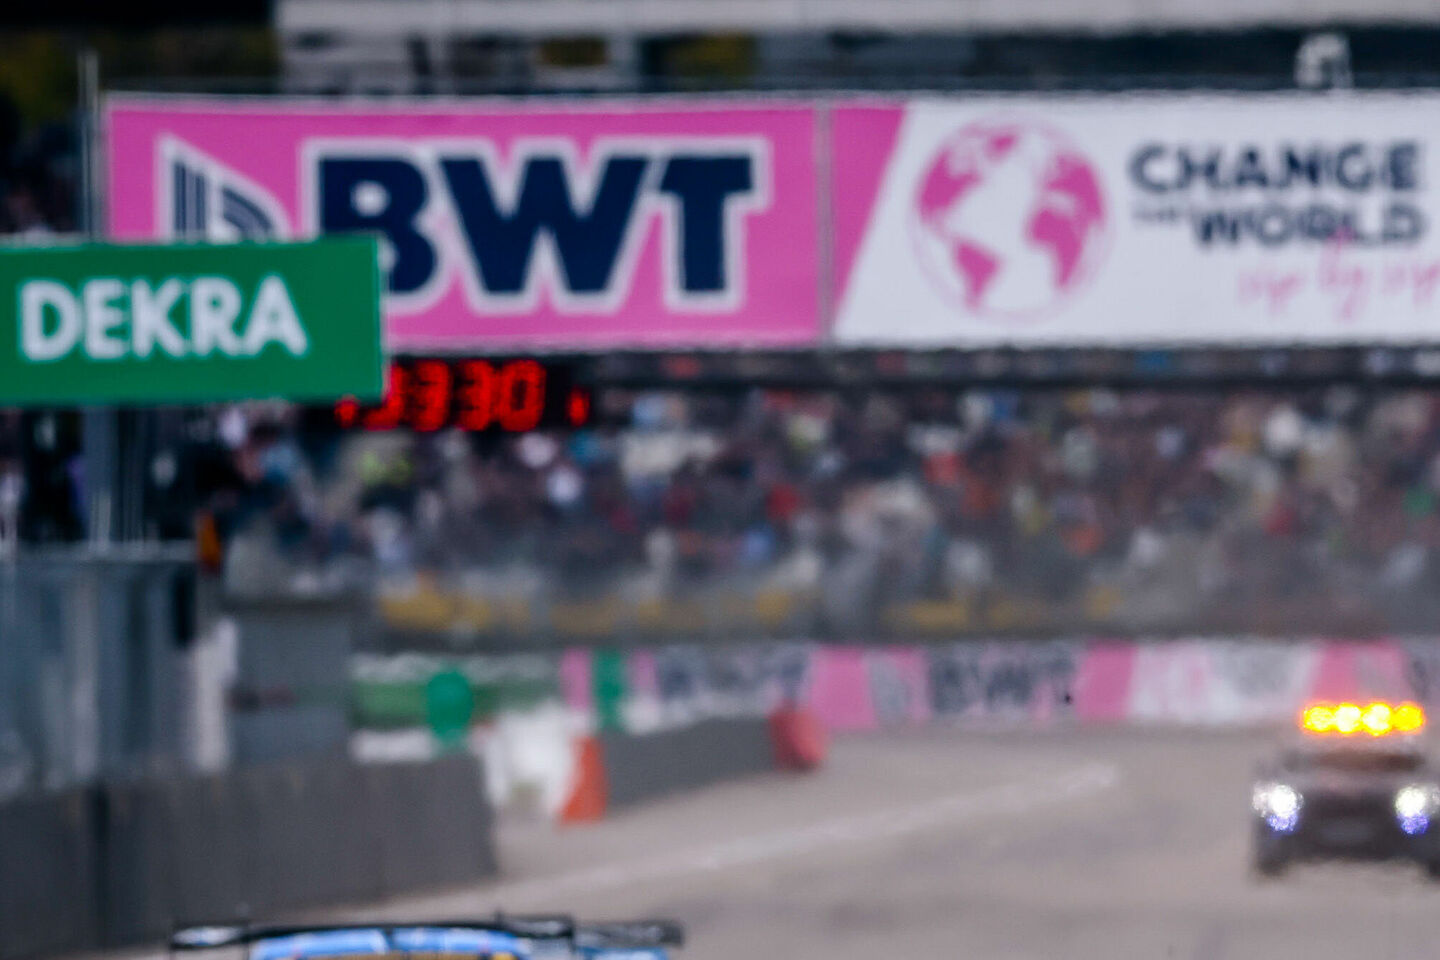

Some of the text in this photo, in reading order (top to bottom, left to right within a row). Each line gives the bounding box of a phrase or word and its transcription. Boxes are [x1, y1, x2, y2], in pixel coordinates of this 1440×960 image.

[1129, 141, 1421, 194] CHANGE
[317, 154, 754, 296] BWT
[1197, 202, 1427, 248] WORLD
[19, 275, 309, 361] DEKRA
